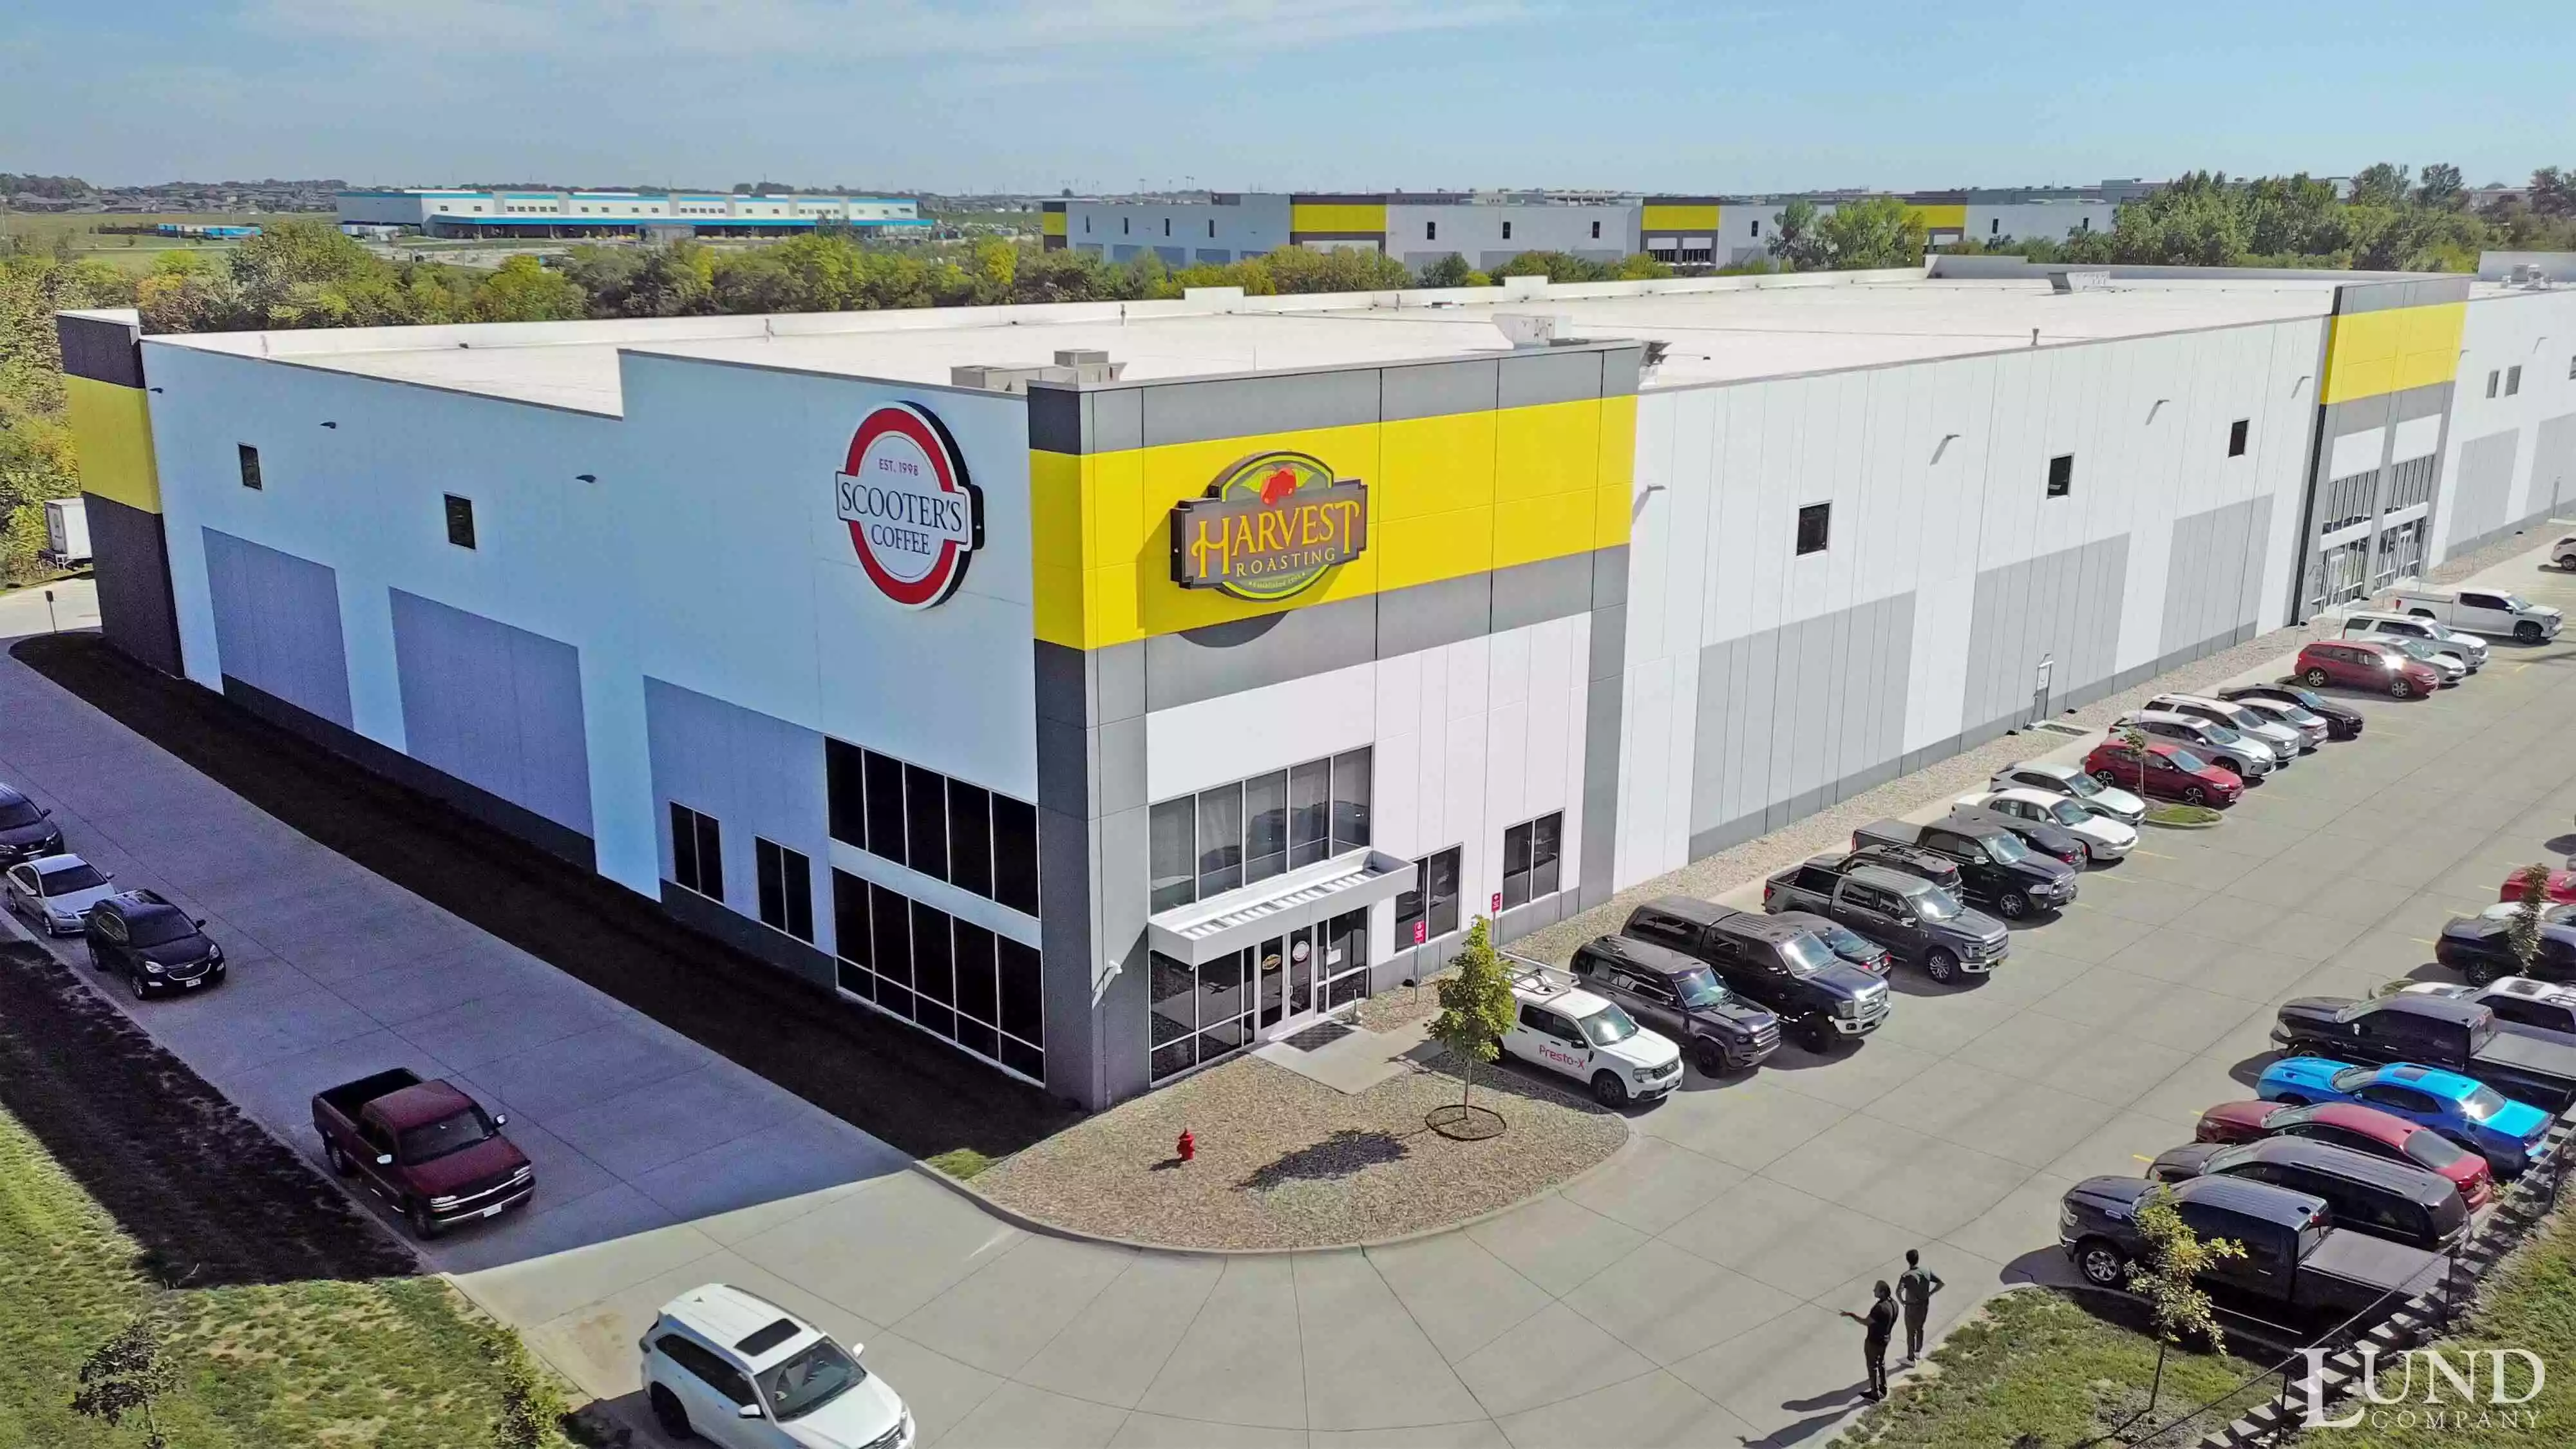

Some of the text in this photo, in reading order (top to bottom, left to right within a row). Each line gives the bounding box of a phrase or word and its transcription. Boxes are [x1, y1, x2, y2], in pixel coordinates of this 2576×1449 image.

[880, 459, 918, 476] EST. 1998
[841, 482, 962, 531] SCOOTER'S
[871, 524, 930, 555] COFFEE
[1191, 500, 1360, 578] HARVEST
[1236, 547, 1336, 578] ROASTING
[1539, 1044, 1585, 1070] Presto-X
